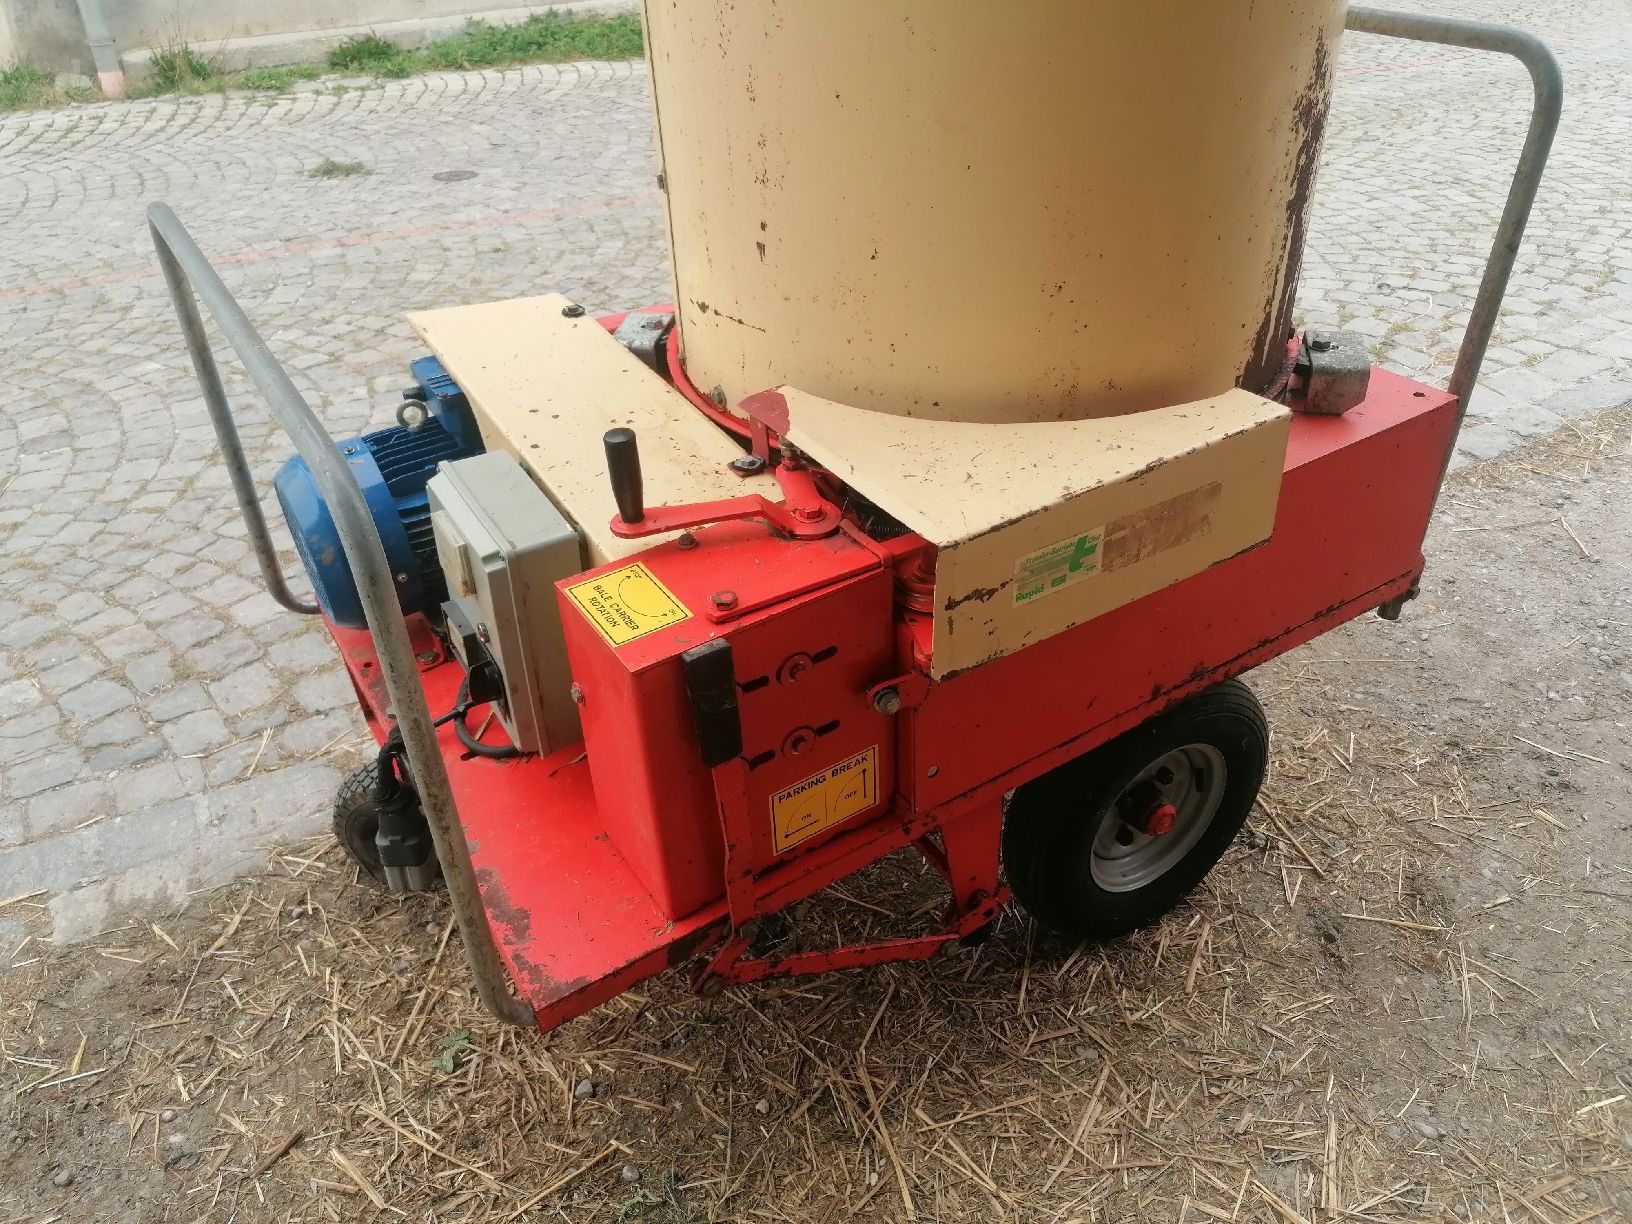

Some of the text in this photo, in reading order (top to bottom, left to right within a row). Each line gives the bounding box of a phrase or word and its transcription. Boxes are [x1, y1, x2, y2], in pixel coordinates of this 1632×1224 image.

[1015, 584, 1044, 602] Rapid
[588, 596, 620, 628] ROTATION
[593, 584, 640, 631] BALE CARRIER
[778, 754, 868, 804] PARKING BREAK
[844, 789, 859, 801] OFF
[801, 812, 812, 821] ON
